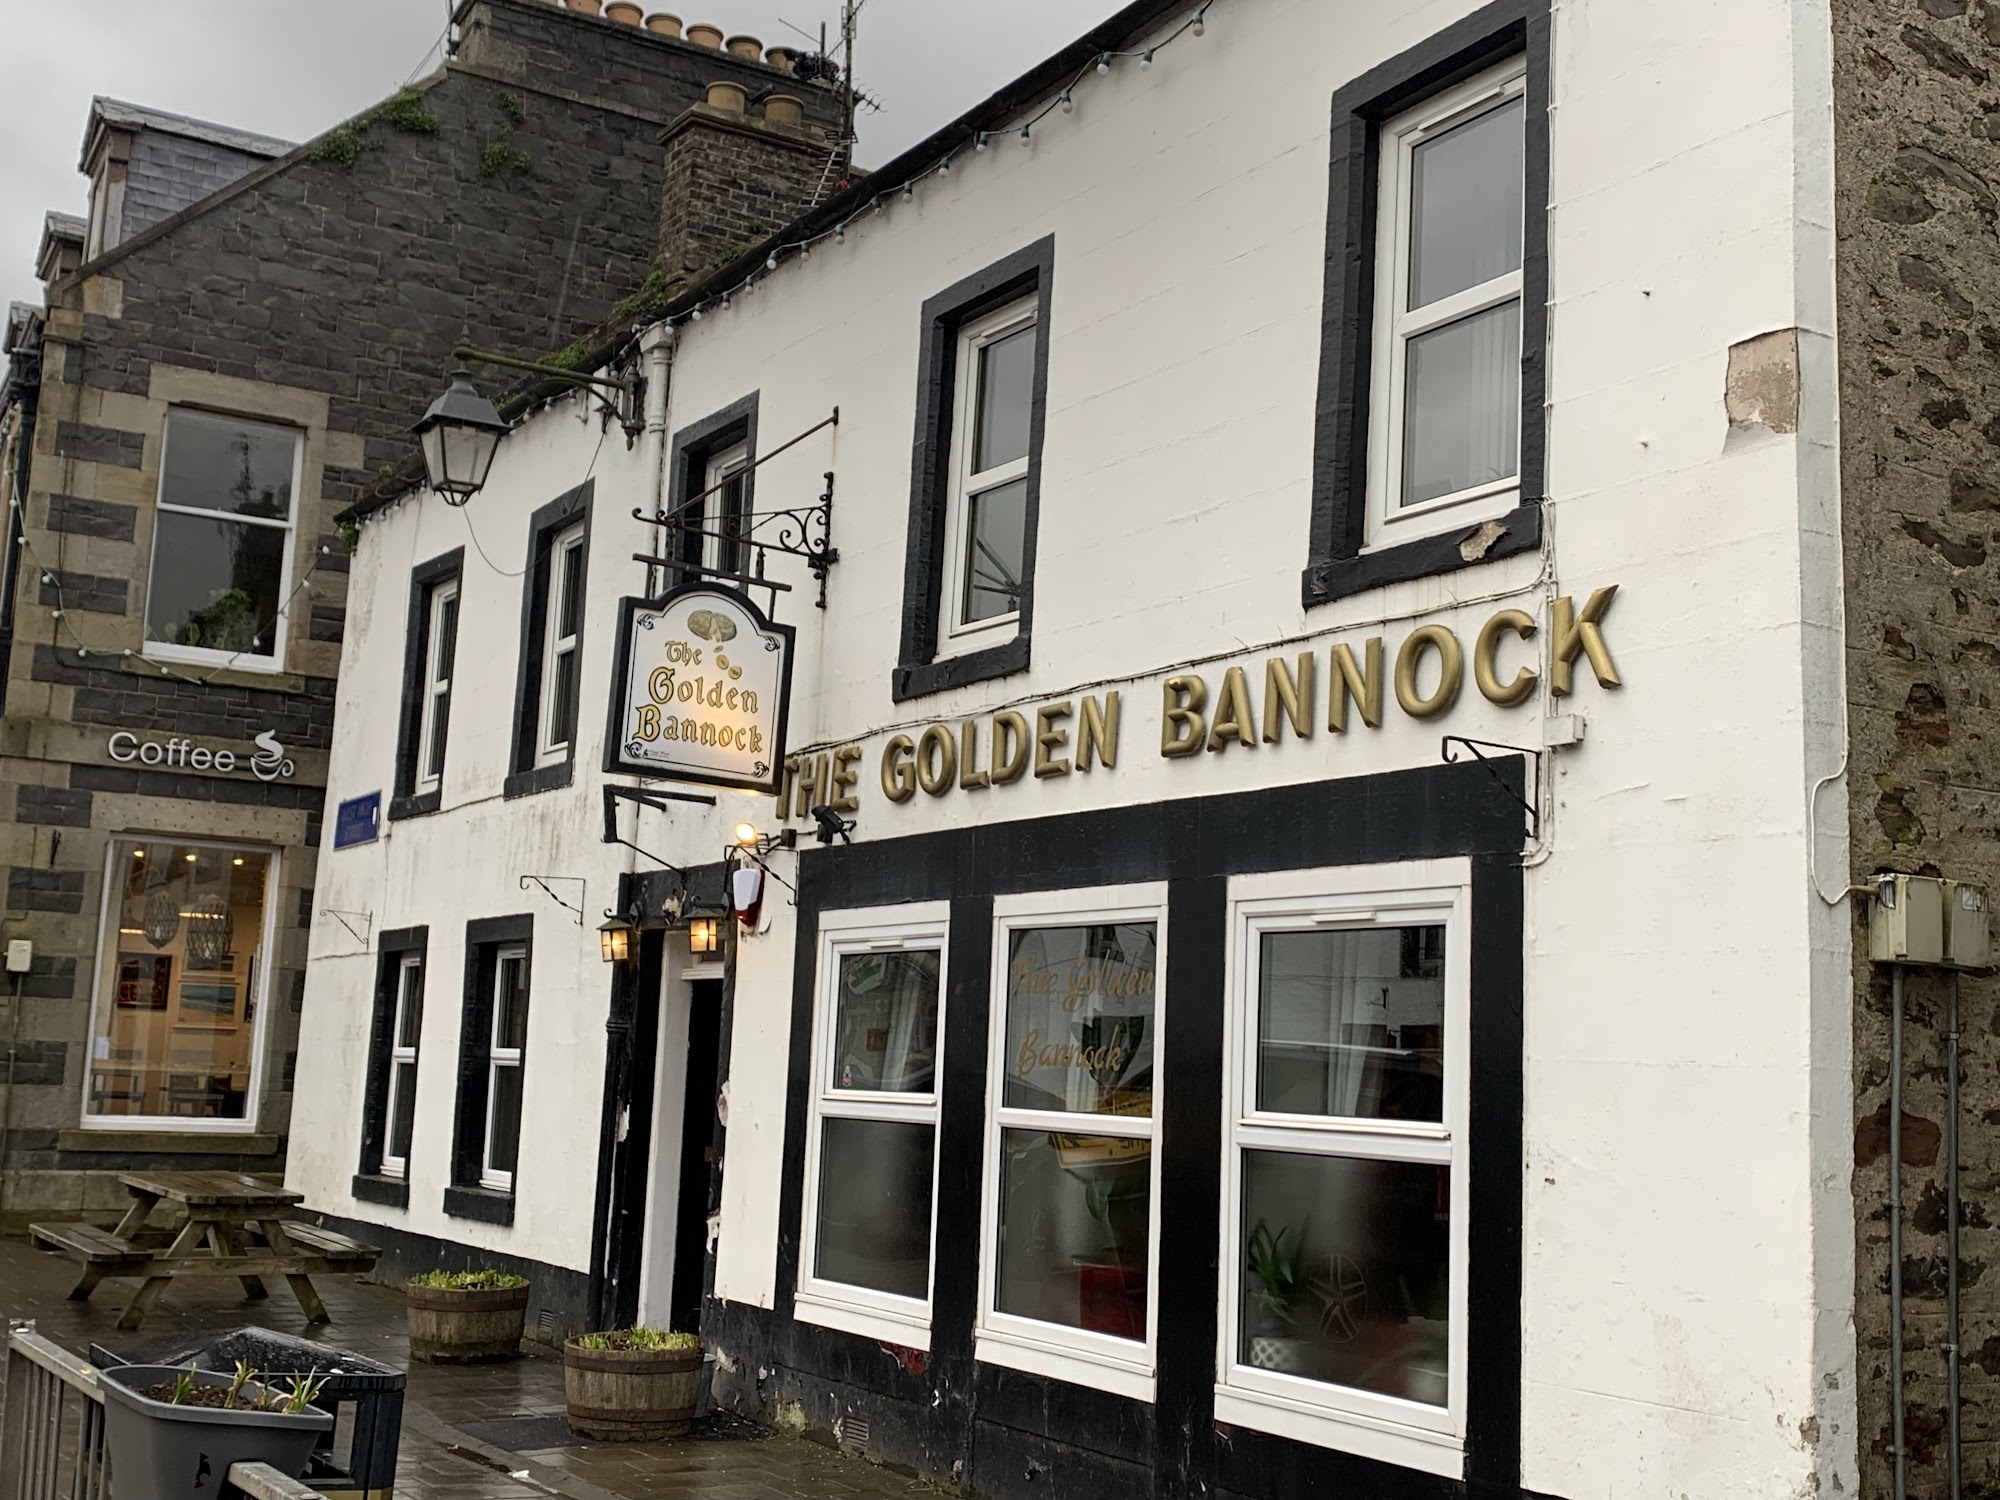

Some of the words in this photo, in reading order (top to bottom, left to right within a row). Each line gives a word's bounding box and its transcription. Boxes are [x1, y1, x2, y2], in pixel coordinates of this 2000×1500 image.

[665, 640, 702, 666] The
[648, 666, 759, 714] Golden
[776, 746, 860, 819] THE
[881, 690, 1120, 803] GOLDEN
[1161, 584, 1621, 758] BANNOCK
[108, 731, 236, 772] Coffee
[632, 704, 763, 753] Bannock
[1010, 955, 1051, 996] The
[1062, 948, 1155, 1013] Golden
[1018, 1024, 1122, 1077] Bannock
